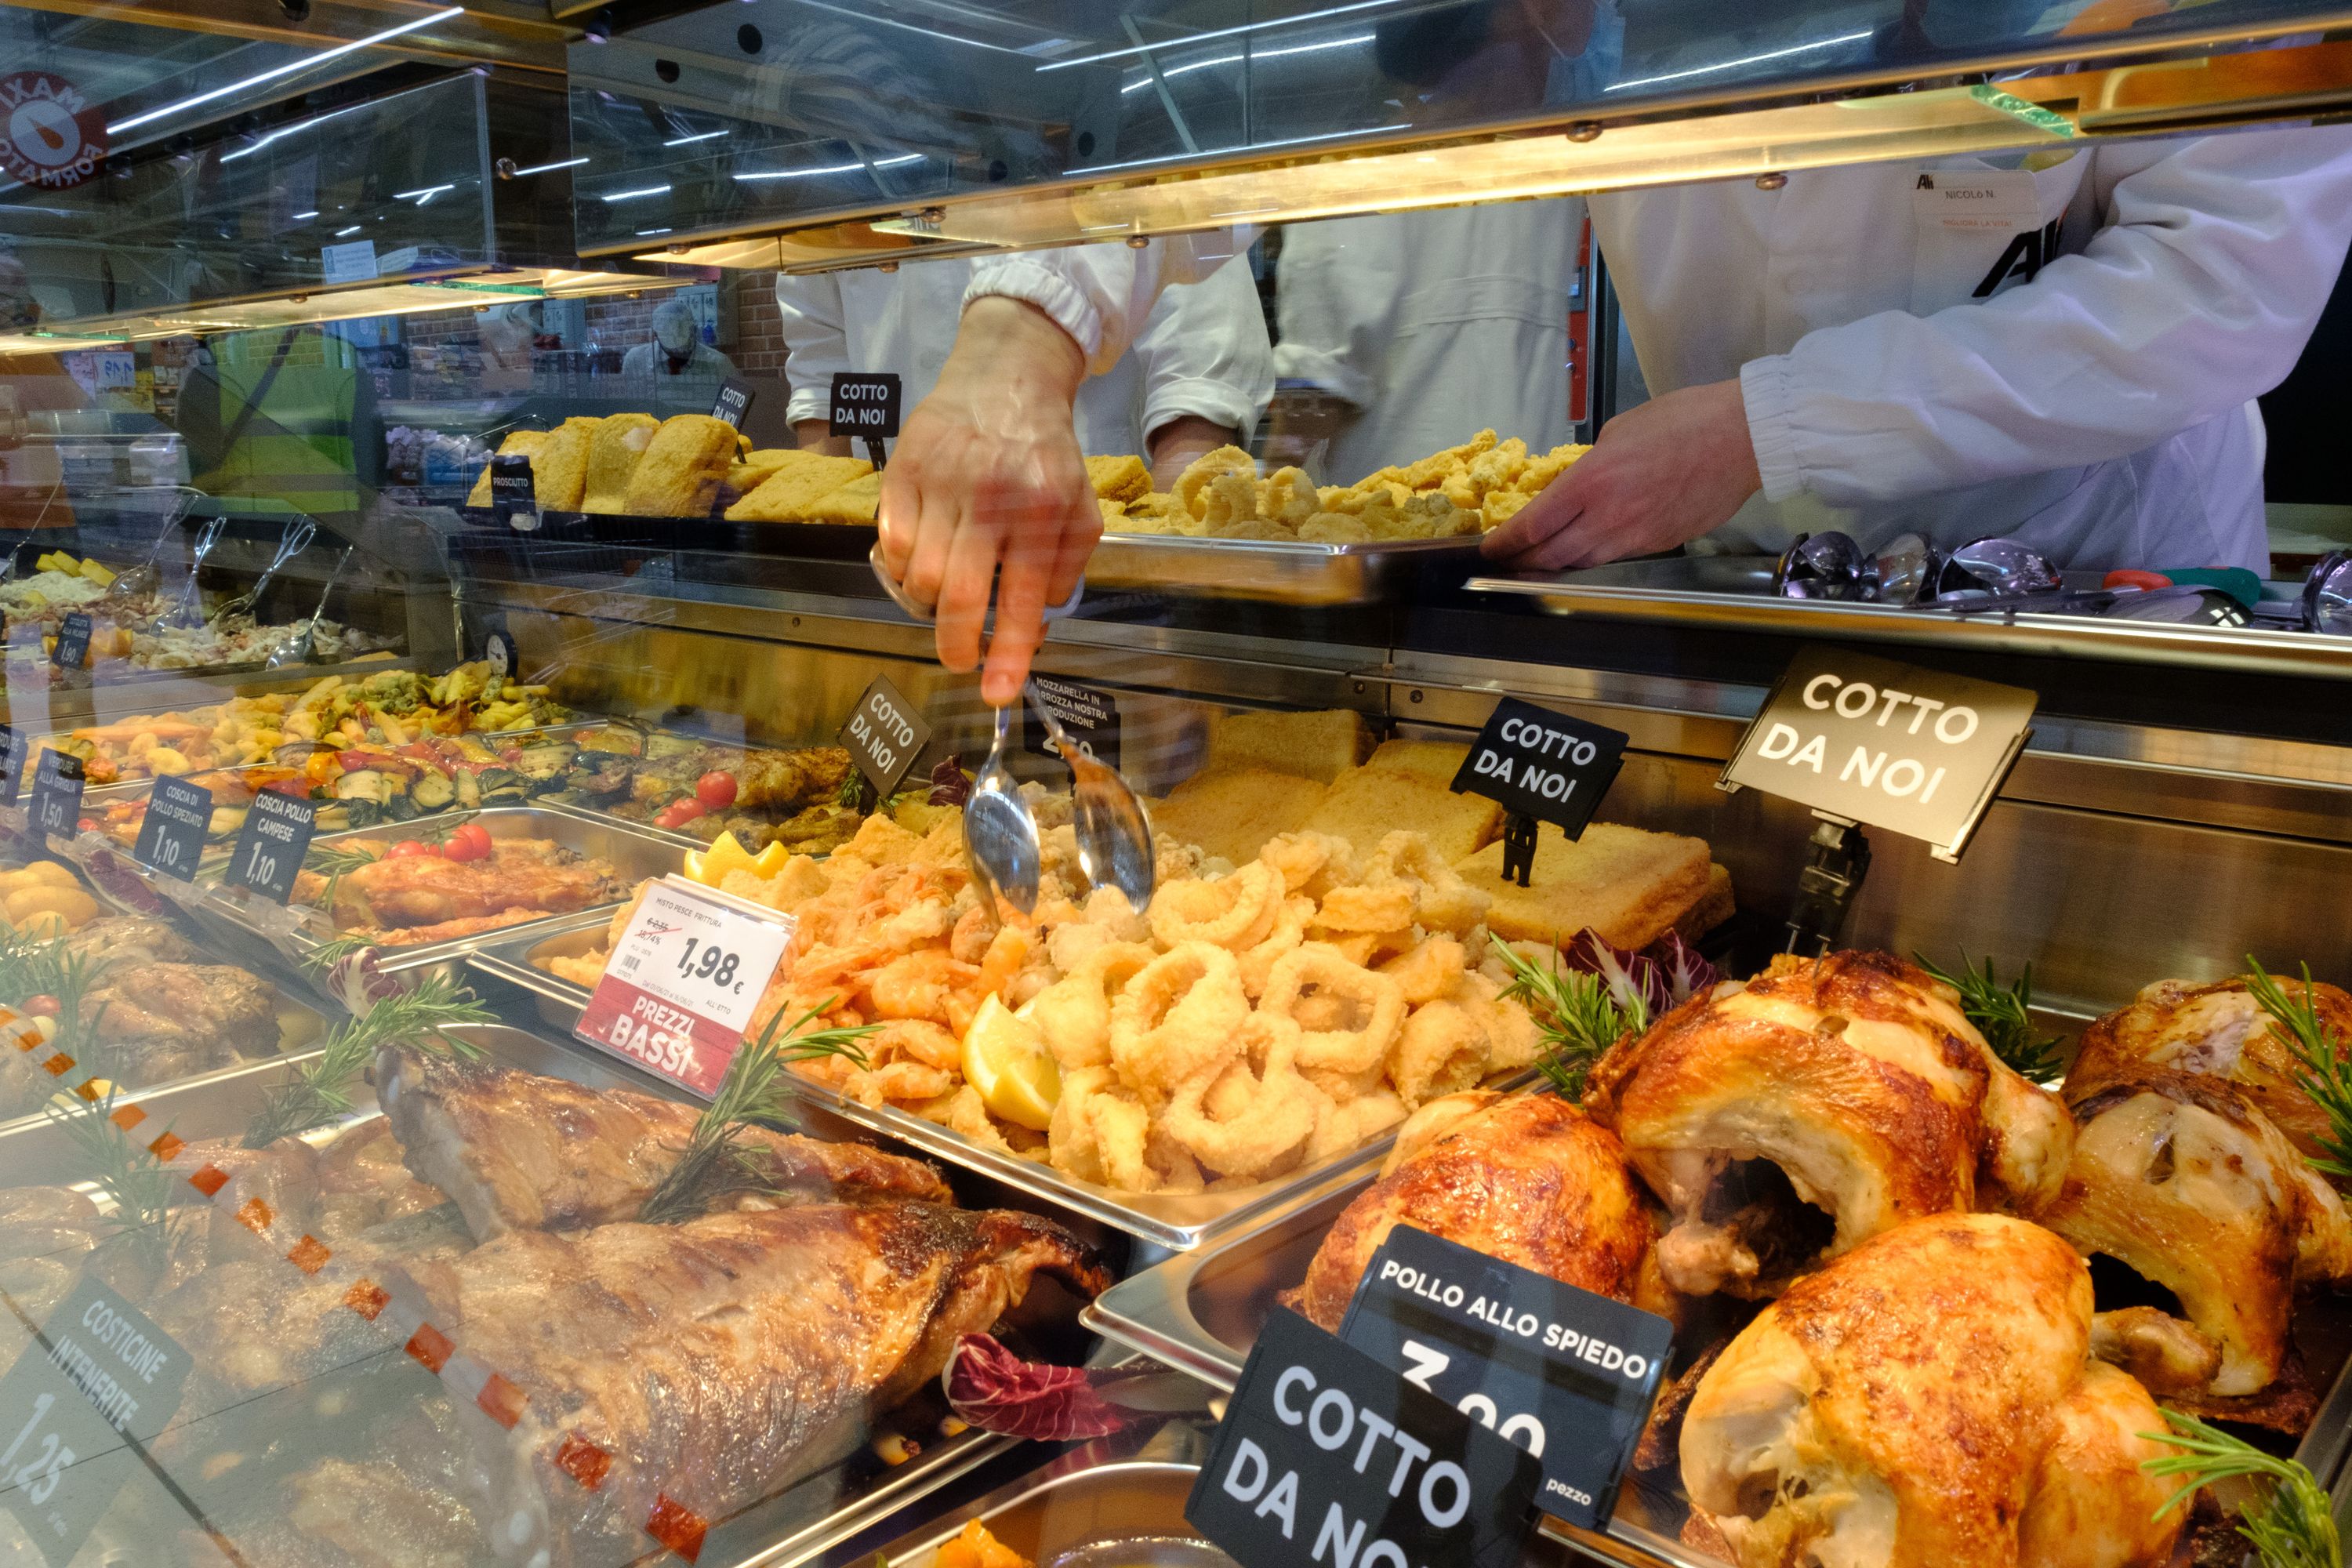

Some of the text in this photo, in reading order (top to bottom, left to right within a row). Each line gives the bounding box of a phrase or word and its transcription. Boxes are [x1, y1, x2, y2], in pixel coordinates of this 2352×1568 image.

[722, 387, 746, 408] COTTO
[840, 383, 888, 401] COTTO
[713, 405, 737, 426] DA NOI
[836, 407, 885, 425] DA NOI
[492, 477, 528, 488] PROSCIUTTO
[1036, 677, 1100, 706] MOZZARELLA IN
[1040, 691, 1108, 720] RROZZA NOSTRA
[870, 692, 914, 747] COTTO
[1047, 706, 1094, 729] RODUZIONE
[1802, 673, 1978, 745] COTTO
[0, 733, 20, 753] RDURE
[849, 714, 897, 775] DA NOI
[1500, 717, 1597, 766] COTTO
[38, 770, 54, 786] ALLA
[48, 754, 75, 775] VERDURE
[1474, 750, 1577, 804] DA NOI
[1756, 724, 1945, 804] DA NOI
[41, 792, 63, 828] 1,50
[151, 798, 203, 828] POLLO SPEZIATO
[166, 786, 198, 807] COSCIA DI
[255, 793, 312, 823] COSCIA POLLO
[153, 825, 180, 866] 1,10
[257, 818, 295, 843] CAMPESE
[246, 841, 276, 885] 1,10
[655, 897, 722, 928] MISTO PESCE FRITTURA
[677, 938, 745, 995] 1,98 €
[632, 995, 695, 1037] PREZZI
[717, 1004, 731, 1015] ETTO
[609, 1013, 695, 1077] BASSI
[1380, 1260, 1647, 1379] POLLO ALLO SPIEDO
[82, 1300, 169, 1385] COSTICINE
[47, 1335, 140, 1433] INTENERITE
[0, 1393, 76, 1505] 1,25
[1273, 1365, 1470, 1528] COTTO
[1222, 1437, 1300, 1540] DA
[1545, 1478, 1592, 1506] pezzo
